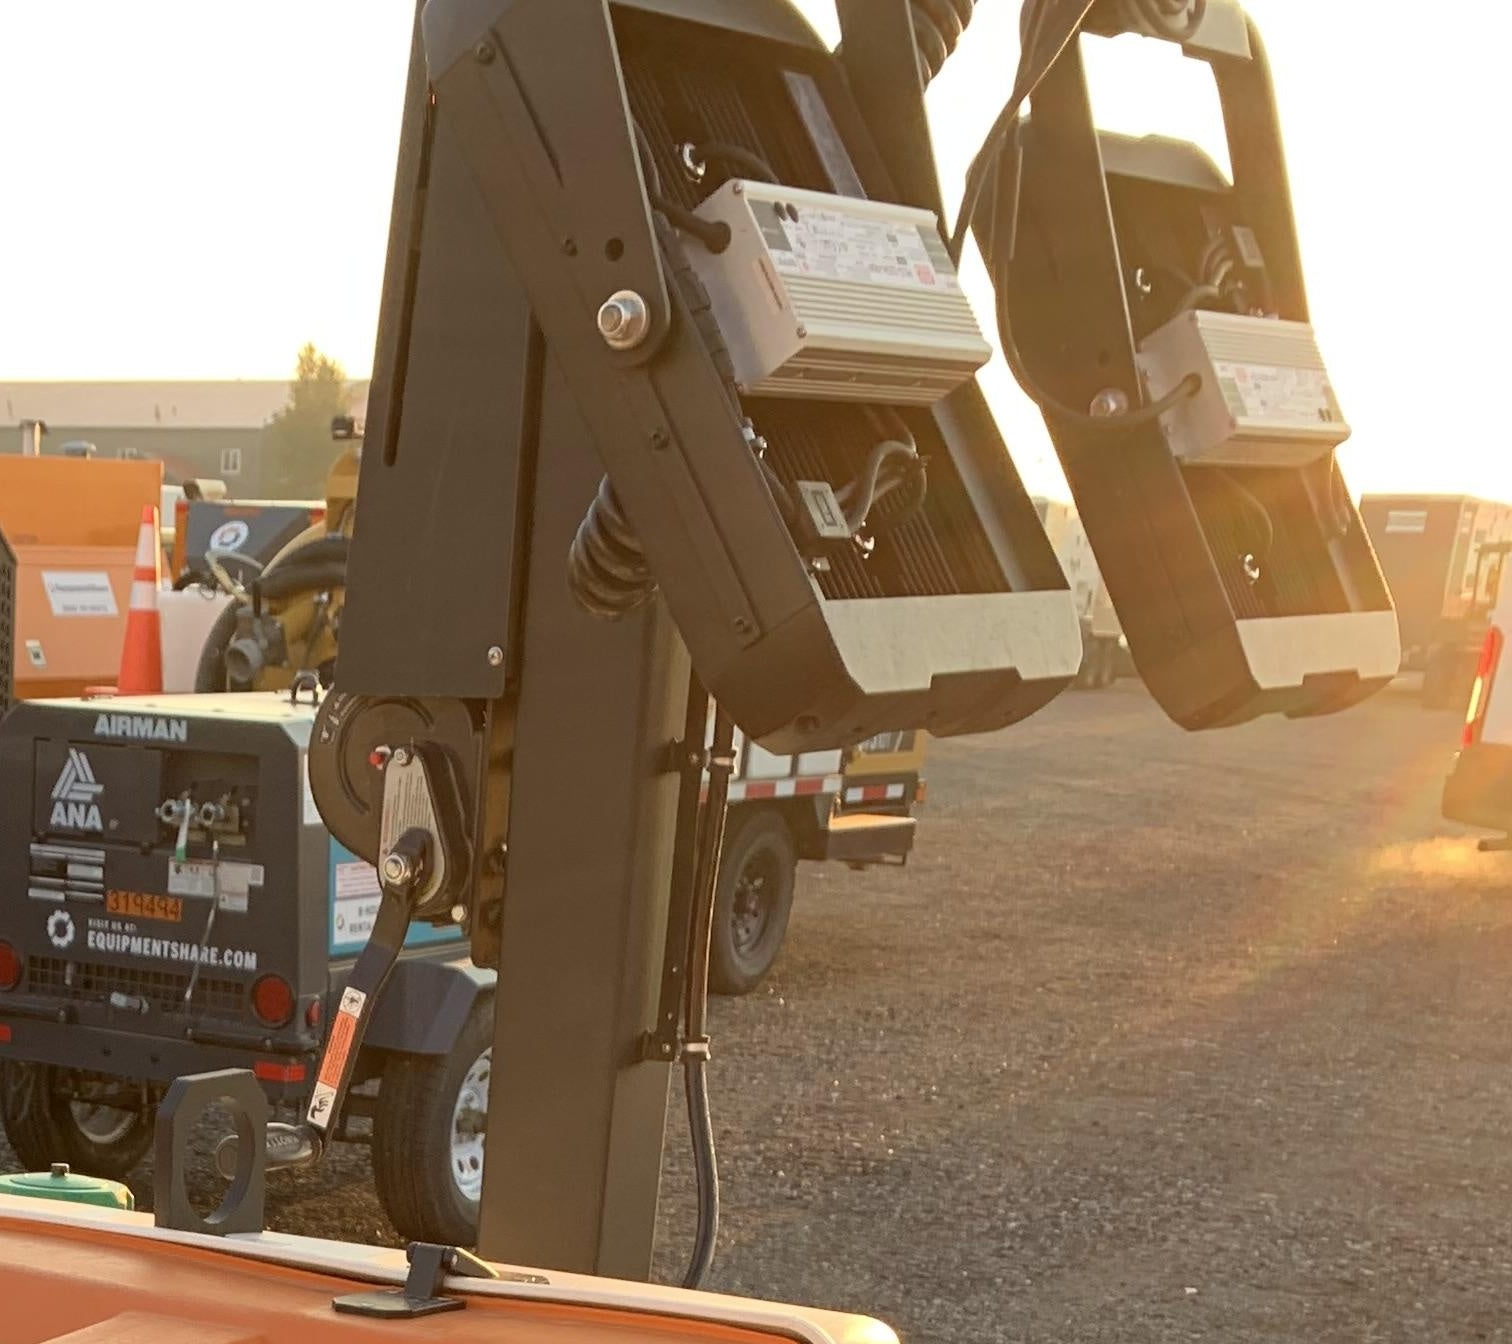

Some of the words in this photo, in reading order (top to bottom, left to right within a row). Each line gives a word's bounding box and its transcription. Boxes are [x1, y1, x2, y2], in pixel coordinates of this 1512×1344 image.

[94, 714, 188, 742] AIRMAN
[50, 801, 104, 831] ANA
[88, 931, 257, 971] EQUIPMENTSHARE.COM
